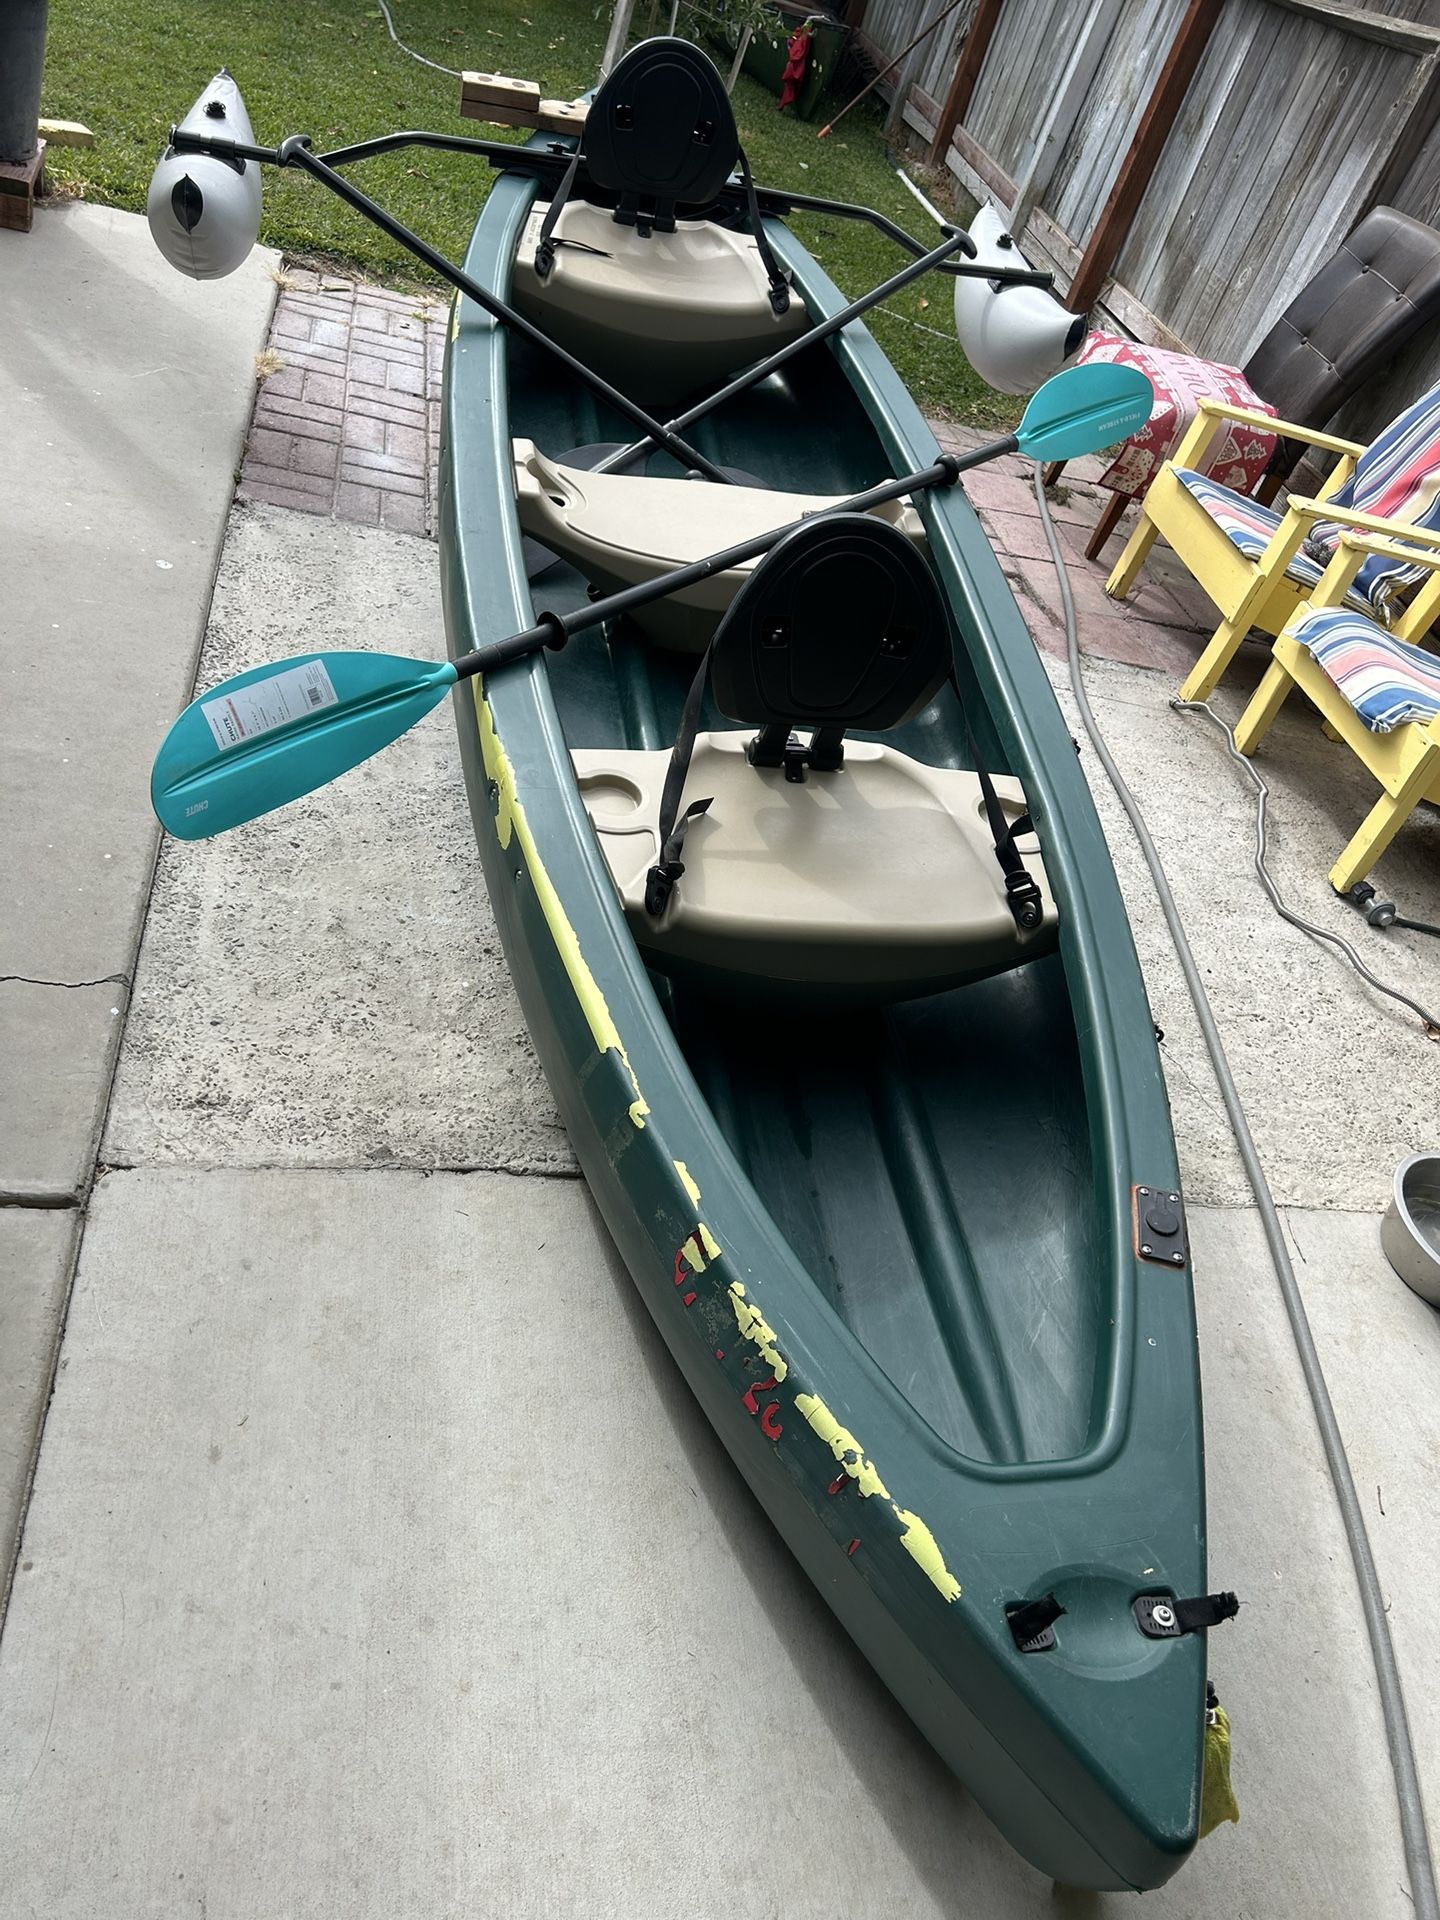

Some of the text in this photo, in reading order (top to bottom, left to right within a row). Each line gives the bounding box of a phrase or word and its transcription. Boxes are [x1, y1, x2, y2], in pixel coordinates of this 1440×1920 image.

[1177, 371, 1212, 399] HO
[1098, 418, 1120, 432] STREAM
[1125, 412, 1141, 423] FIELD
[222, 716, 237, 742] CHUTE
[184, 800, 209, 817] CHUTE
